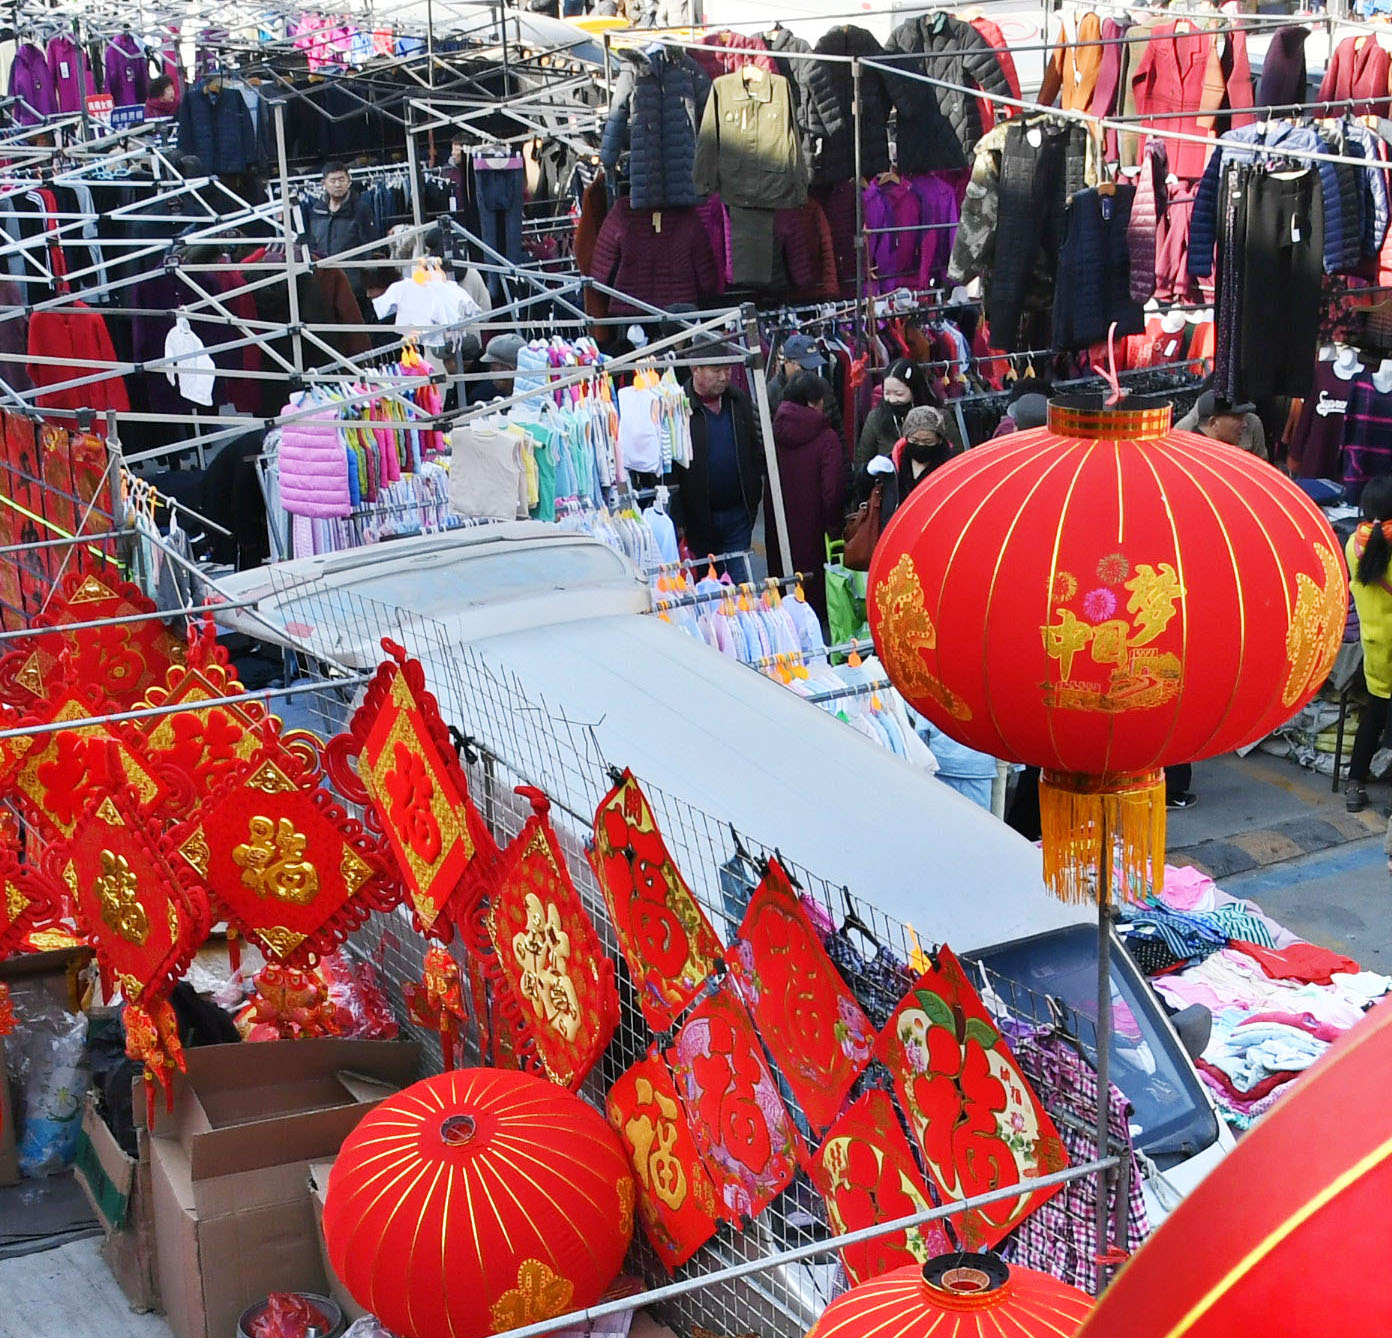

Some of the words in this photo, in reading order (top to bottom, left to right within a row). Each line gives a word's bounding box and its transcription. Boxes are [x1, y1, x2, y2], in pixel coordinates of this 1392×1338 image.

[1040, 563, 1188, 682] 中国梦
[232, 815, 321, 905] 福
[383, 740, 443, 865] 福
[94, 848, 150, 947] 福
[513, 892, 583, 1044] 福
[625, 1076, 687, 1211] 福
[693, 1015, 773, 1176] 福
